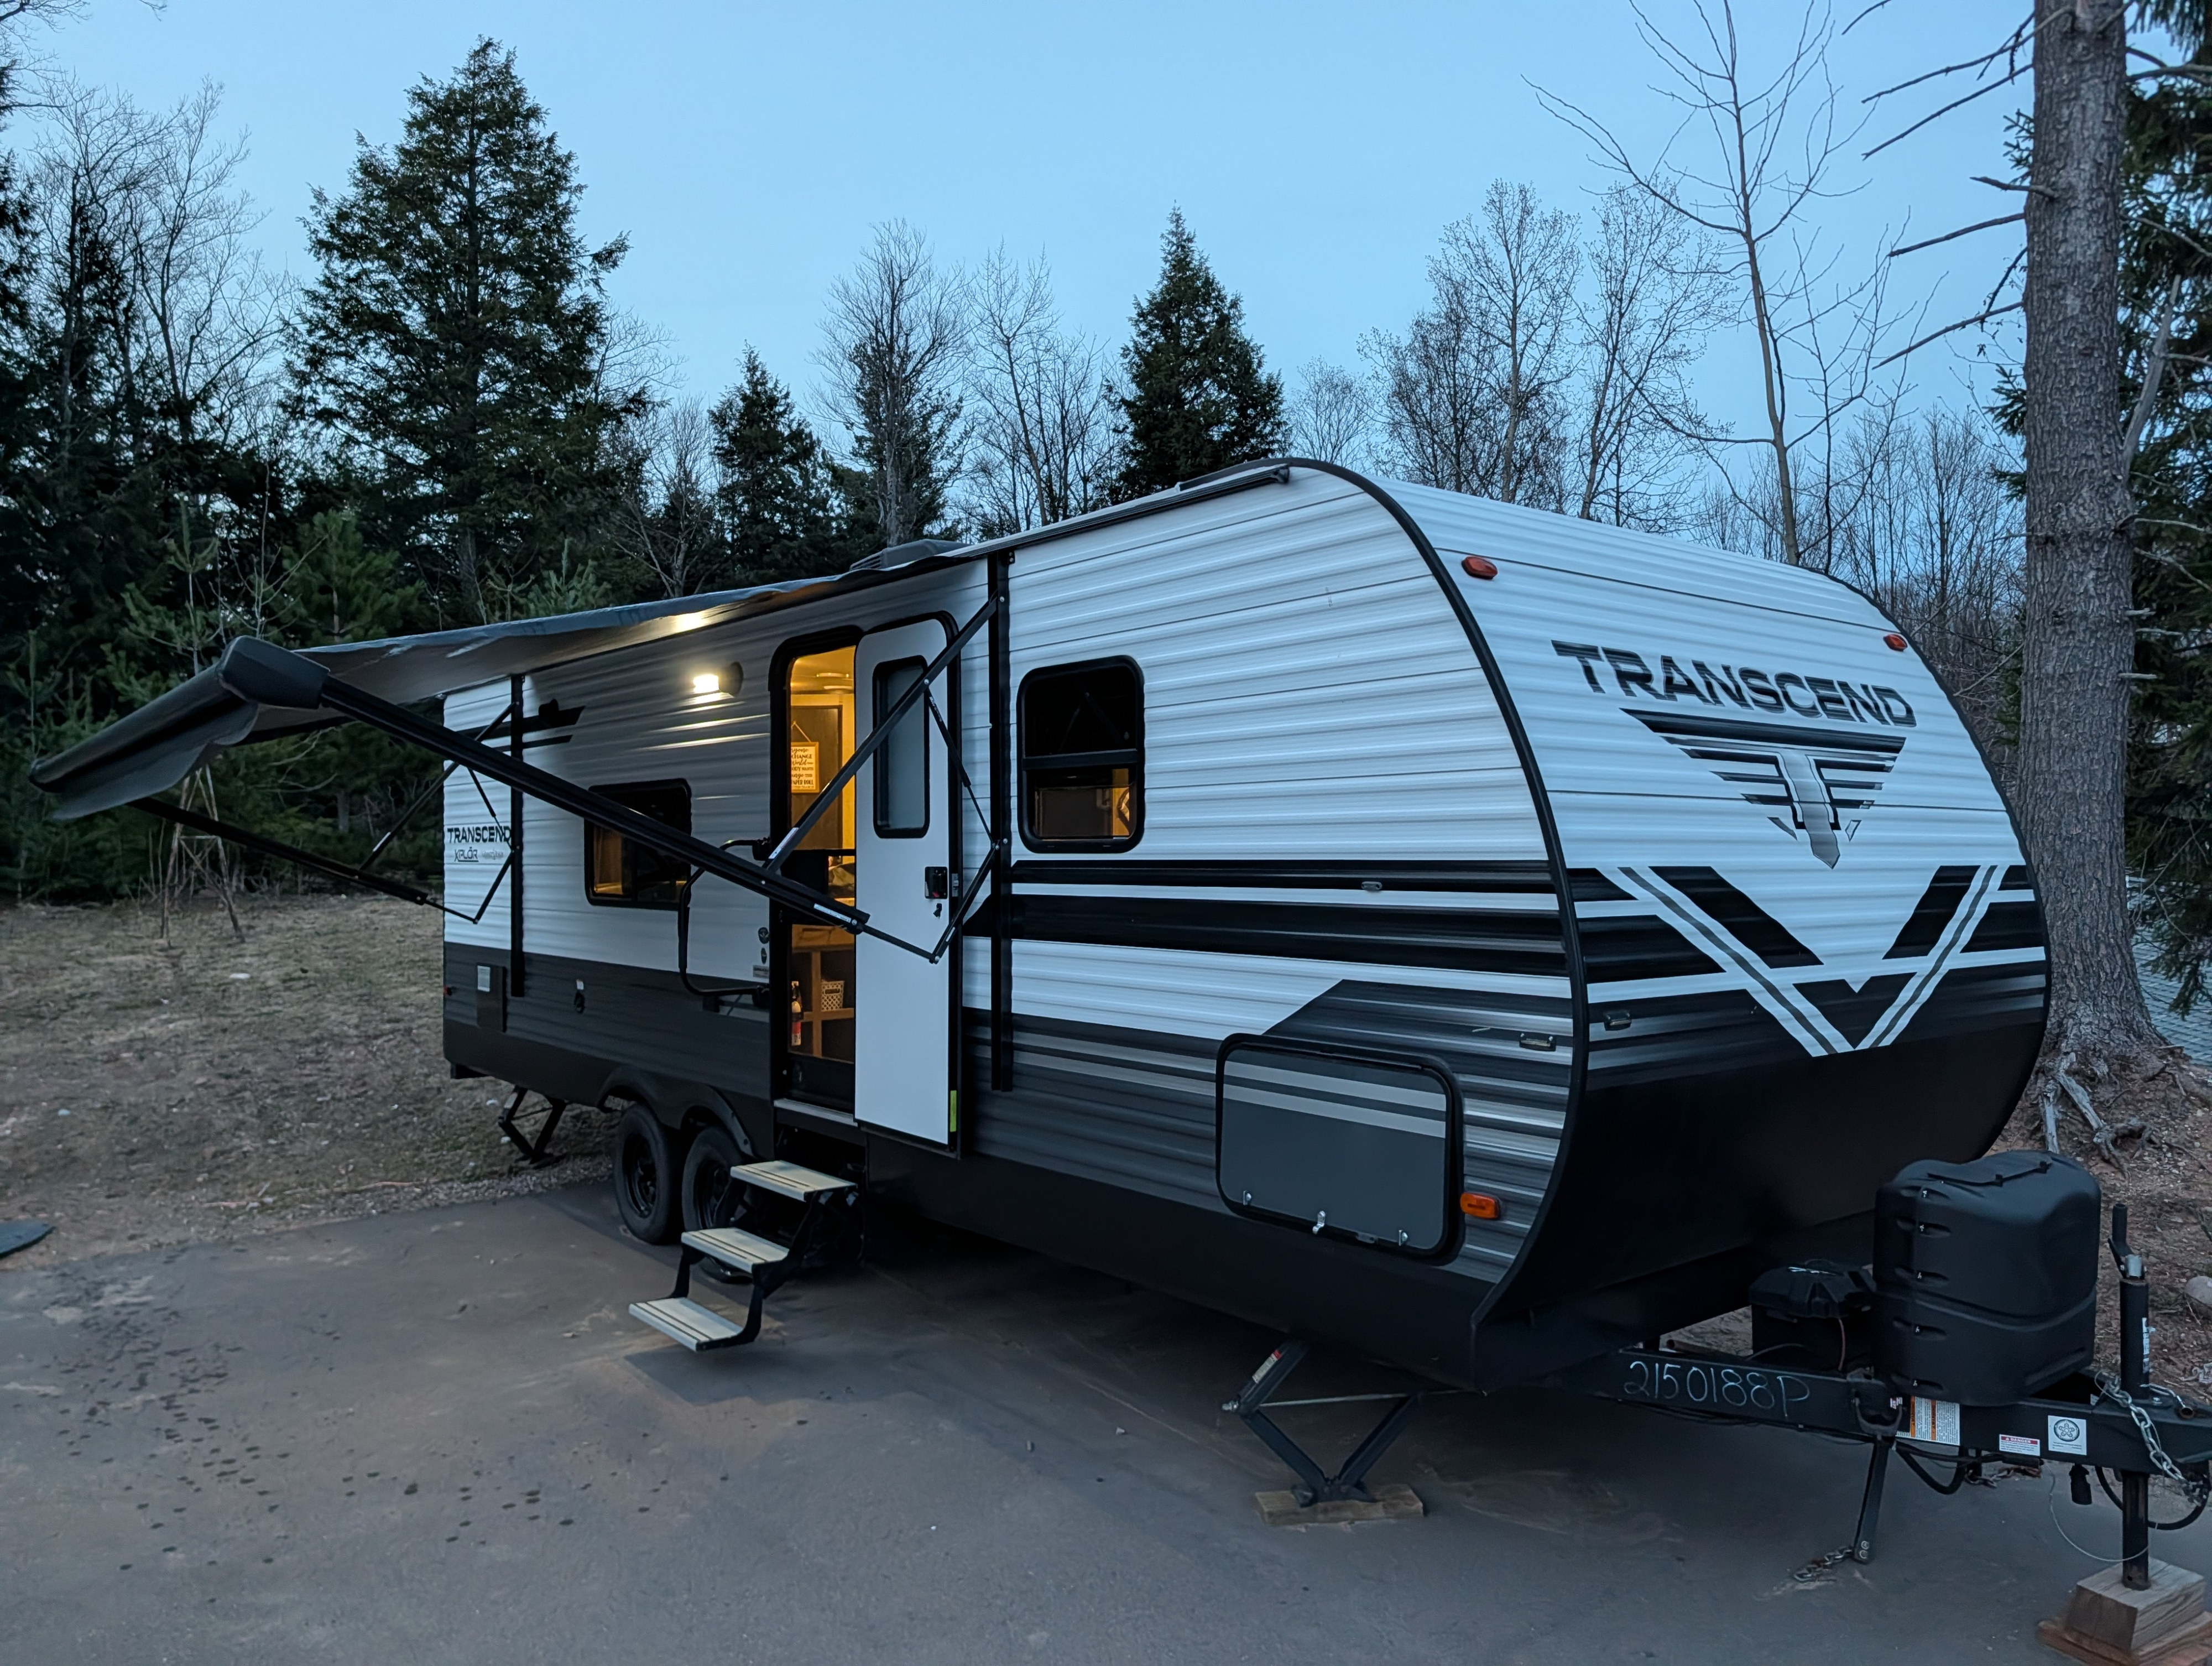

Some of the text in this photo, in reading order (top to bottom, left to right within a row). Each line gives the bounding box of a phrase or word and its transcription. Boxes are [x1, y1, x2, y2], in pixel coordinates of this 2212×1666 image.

[1552, 640, 1917, 727] TRANSCEND
[447, 825, 512, 843] TRANSCEND
[1624, 1361, 1810, 1417] 2150188P
